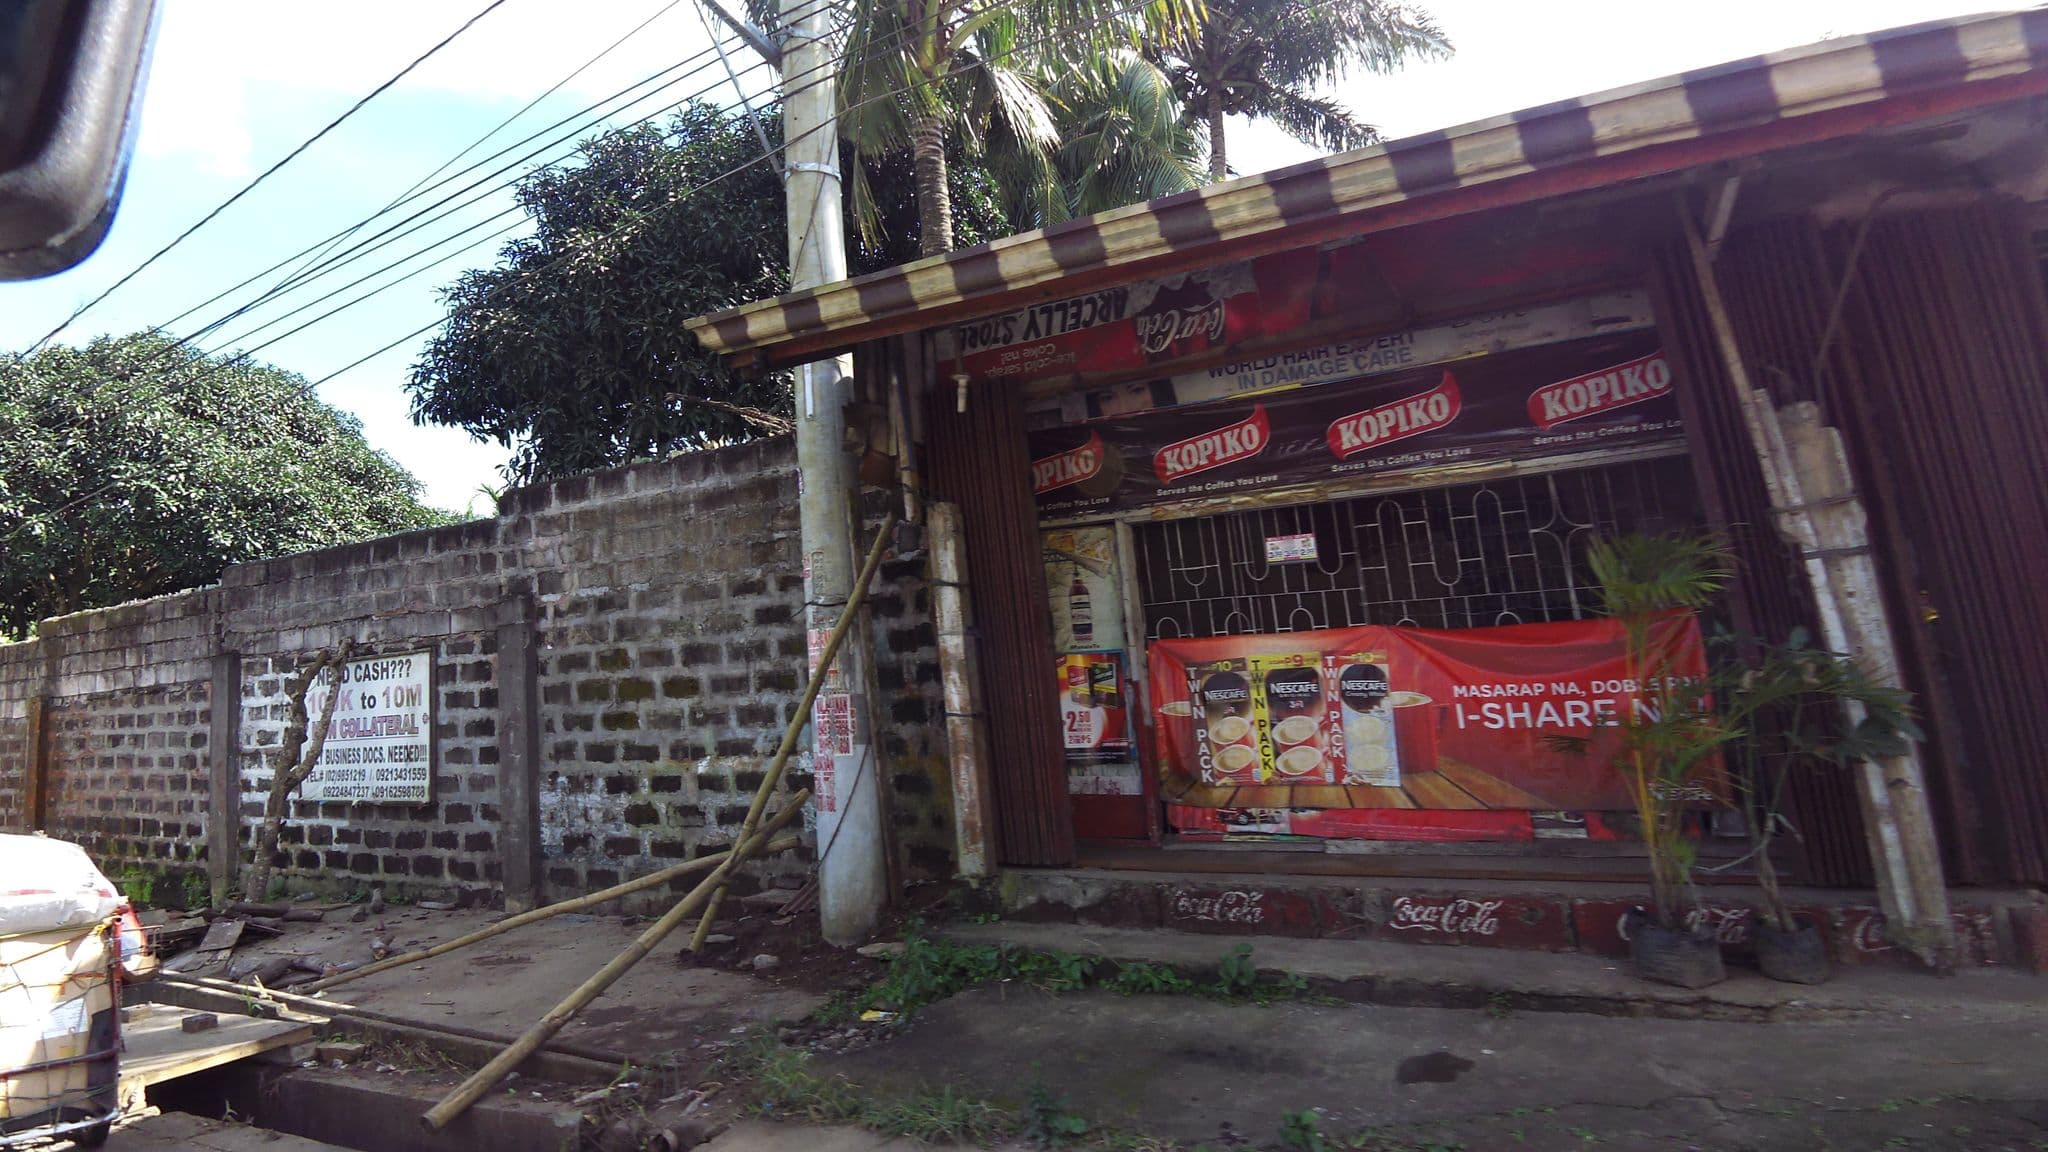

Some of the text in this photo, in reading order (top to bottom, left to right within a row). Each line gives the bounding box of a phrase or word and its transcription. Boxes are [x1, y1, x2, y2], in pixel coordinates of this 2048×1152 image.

[1136, 302, 1226, 353] Coca-Cola
[1238, 346, 1414, 389] IN DAMAGE CARE
[1537, 354, 1672, 421] KOPIKO
[1338, 392, 1450, 451] KOPIKO
[1534, 433, 1575, 446] Serves
[1599, 425, 1641, 438] Coffee
[1164, 422, 1262, 475] KOPIKO
[1331, 446, 1472, 473] Serves the Coffee You Love
[1156, 486, 1187, 497] Serves
[1205, 479, 1236, 491] Coffee
[1237, 476, 1255, 487] You
[1256, 473, 1279, 484] Love
[315, 658, 412, 687] NED CASH???
[1453, 682, 1545, 698] MASARAP
[1551, 681, 1587, 697] NA,
[309, 683, 422, 714] 10K to 10M
[1252, 660, 1274, 771] TWIN PACK
[1324, 655, 1345, 758] TWIN PACK
[1456, 700, 1620, 730] I-SHARE
[339, 713, 420, 739] COLLATERAL
[1187, 667, 1214, 783] TWIN PACK
[325, 749, 360, 765] BUSINESS
[362, 747, 385, 763] DOCS.
[1390, 897, 1504, 934] Coca-Cola
